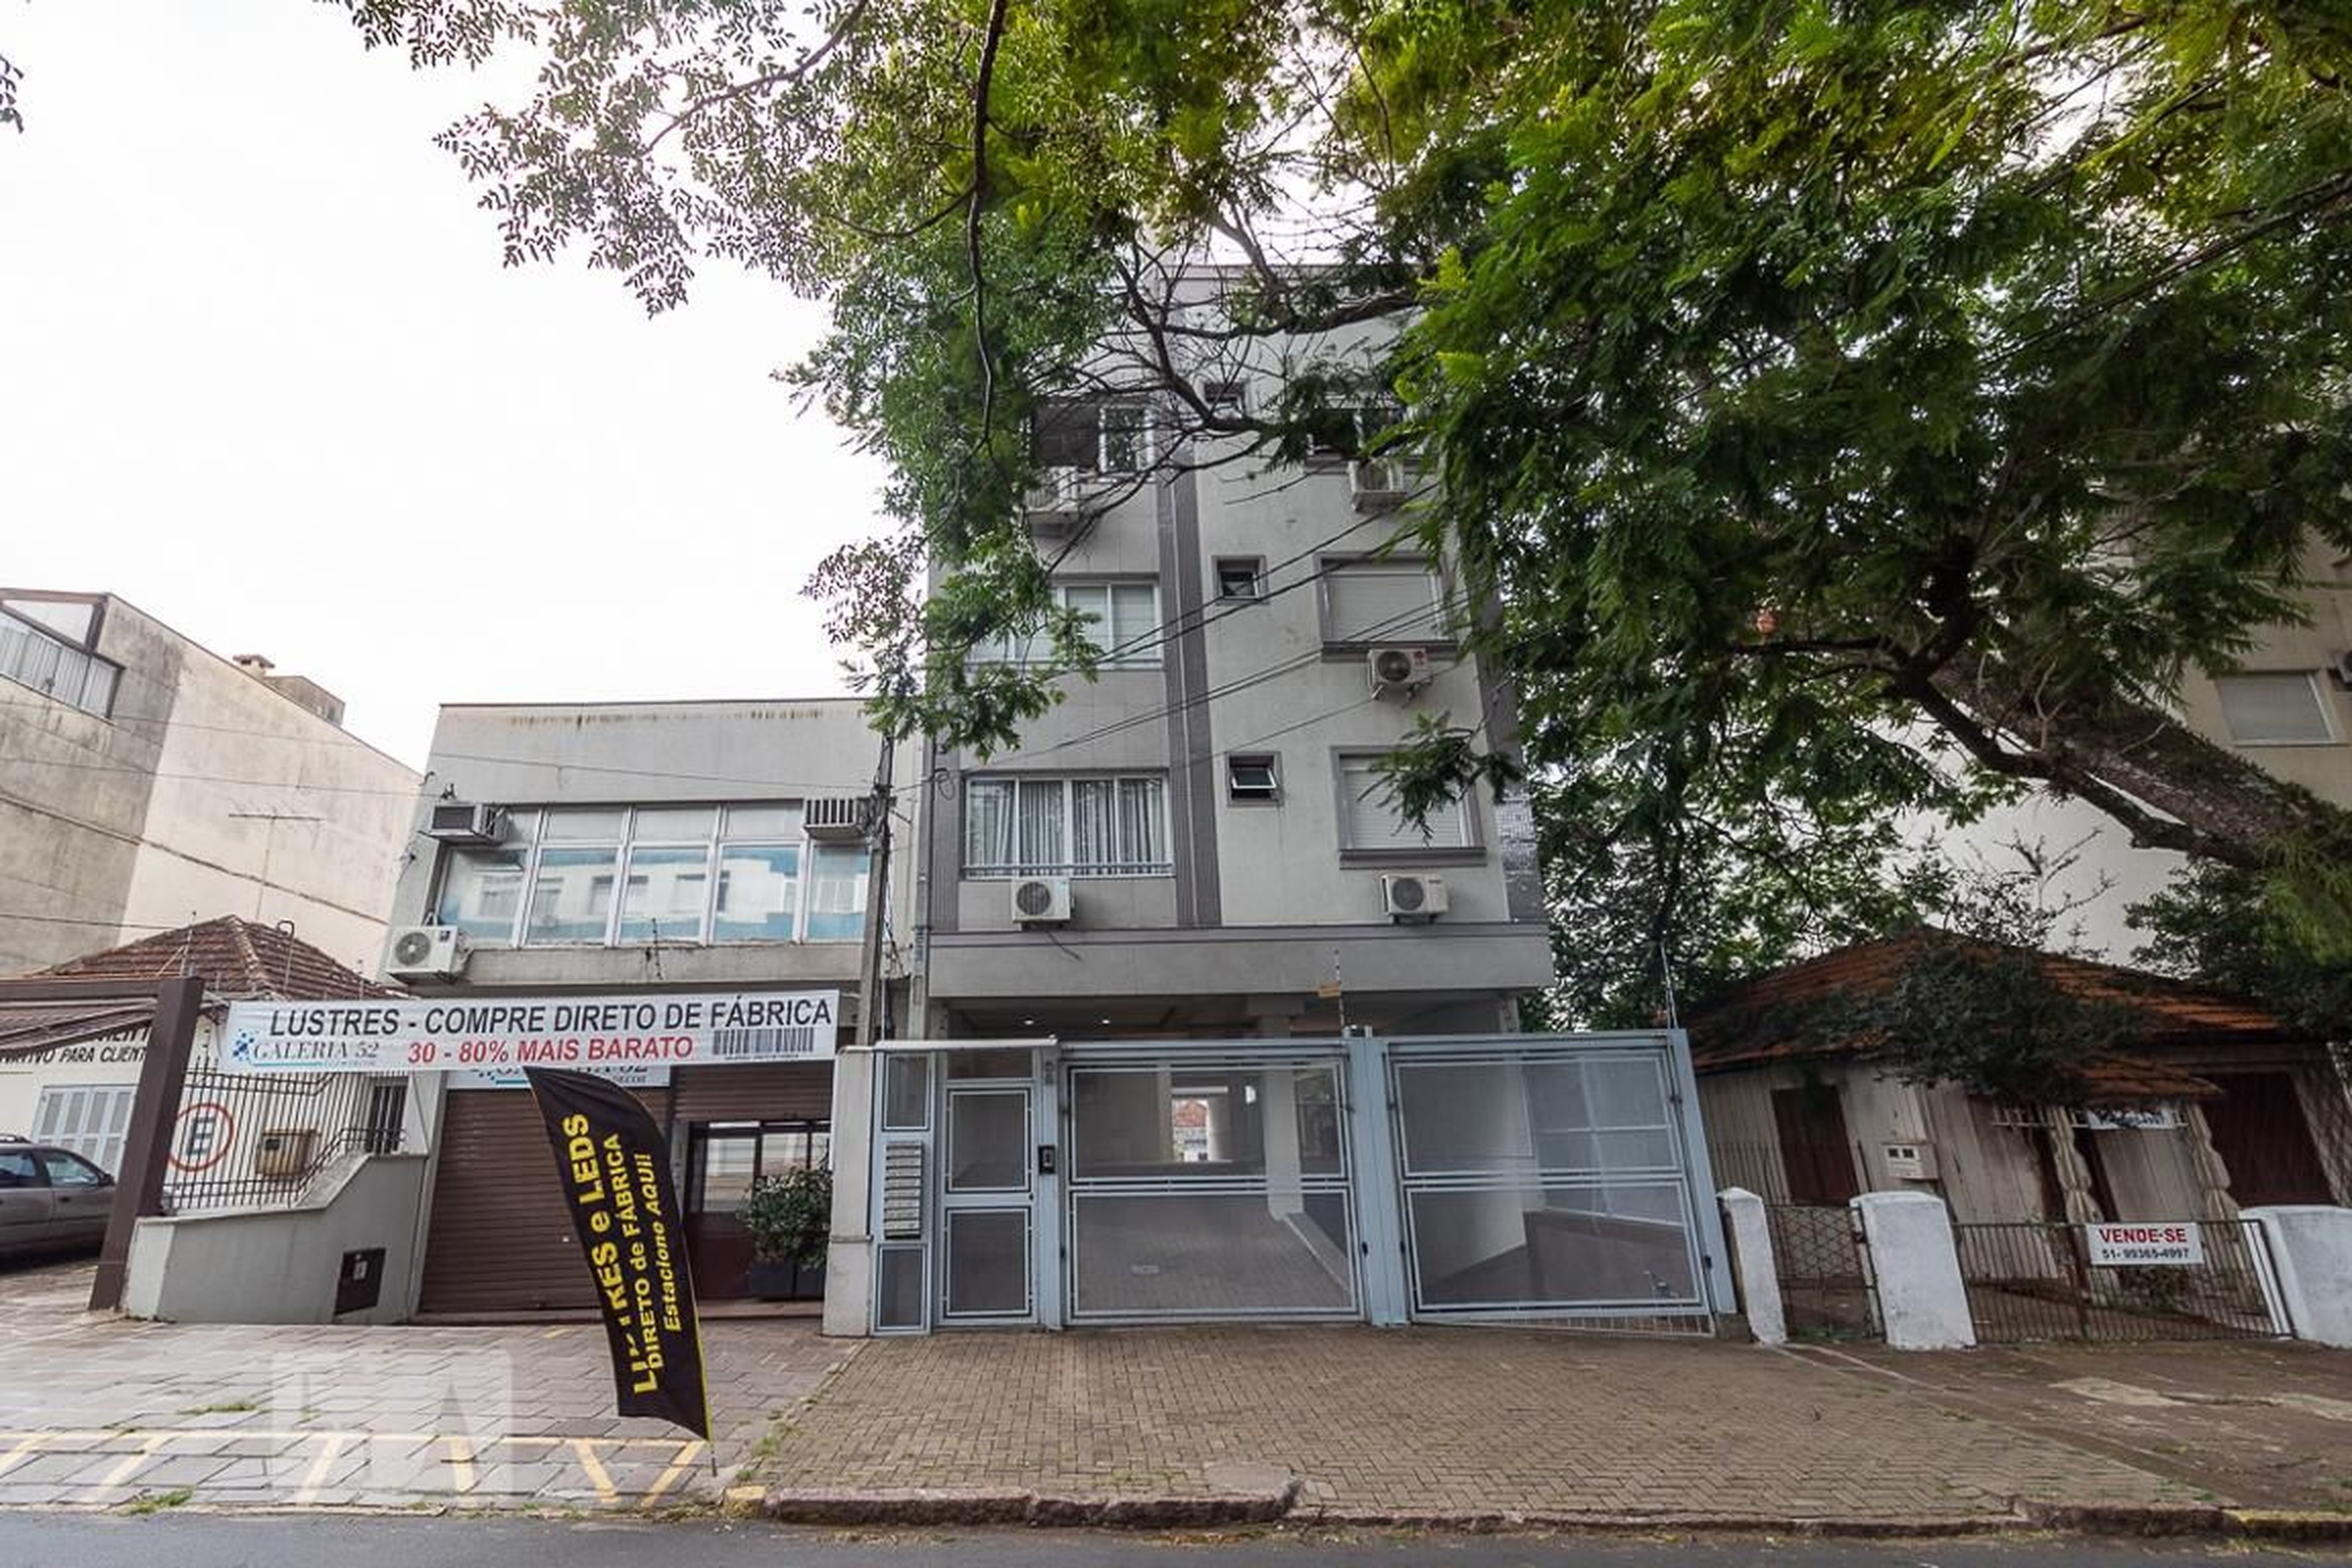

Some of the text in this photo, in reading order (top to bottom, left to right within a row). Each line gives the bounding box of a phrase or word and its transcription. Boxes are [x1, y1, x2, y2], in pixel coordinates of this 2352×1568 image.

[270, 1009, 400, 1036] LUSTRES
[424, 1006, 546, 1034] COMPRE
[553, 1003, 656, 1031] DIRETO
[664, 1002, 703, 1028] DE
[710, 995, 832, 1028] FÁBRICA
[59, 1046, 95, 1063] PARA
[254, 1041, 379, 1060] GALERIA 52
[407, 1042, 436, 1063] 30
[459, 1041, 509, 1063] 80%
[516, 1039, 579, 1061] MAIS
[587, 1036, 693, 1060] BARATO
[562, 1114, 605, 1204] LEDS
[590, 1210, 611, 1232] e
[2098, 1228, 2188, 1243] VENDE-SE
[604, 1133, 665, 1370] DIRETO de FÁBRICA
[652, 1221, 682, 1332] Estaciono
